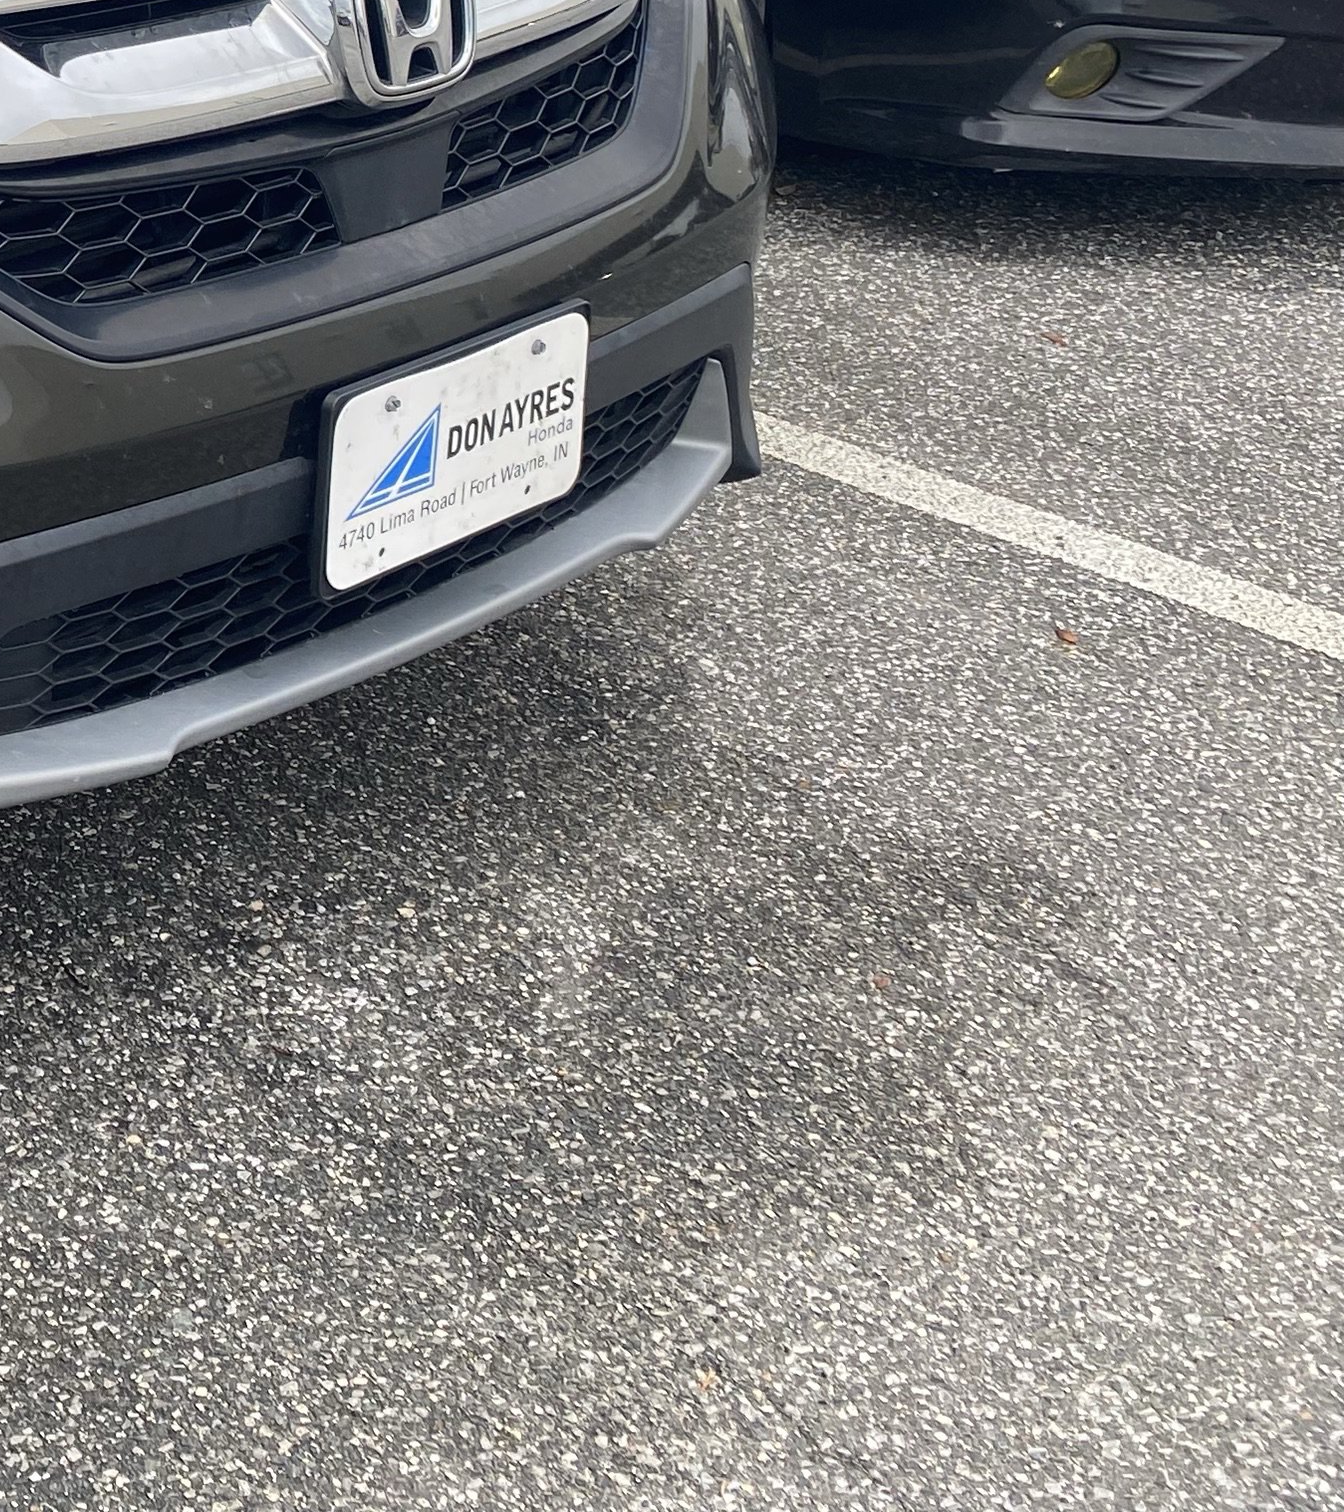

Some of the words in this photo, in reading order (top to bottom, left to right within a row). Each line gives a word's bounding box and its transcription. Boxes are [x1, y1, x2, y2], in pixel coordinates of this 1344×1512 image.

[528, 416, 573, 446] Honda
[338, 522, 375, 550] 4740
[380, 508, 415, 534] Lima
[420, 489, 457, 518] Road
[470, 473, 497, 498] Fort
[500, 454, 549, 483] Wayne,
[553, 441, 569, 462] IN
